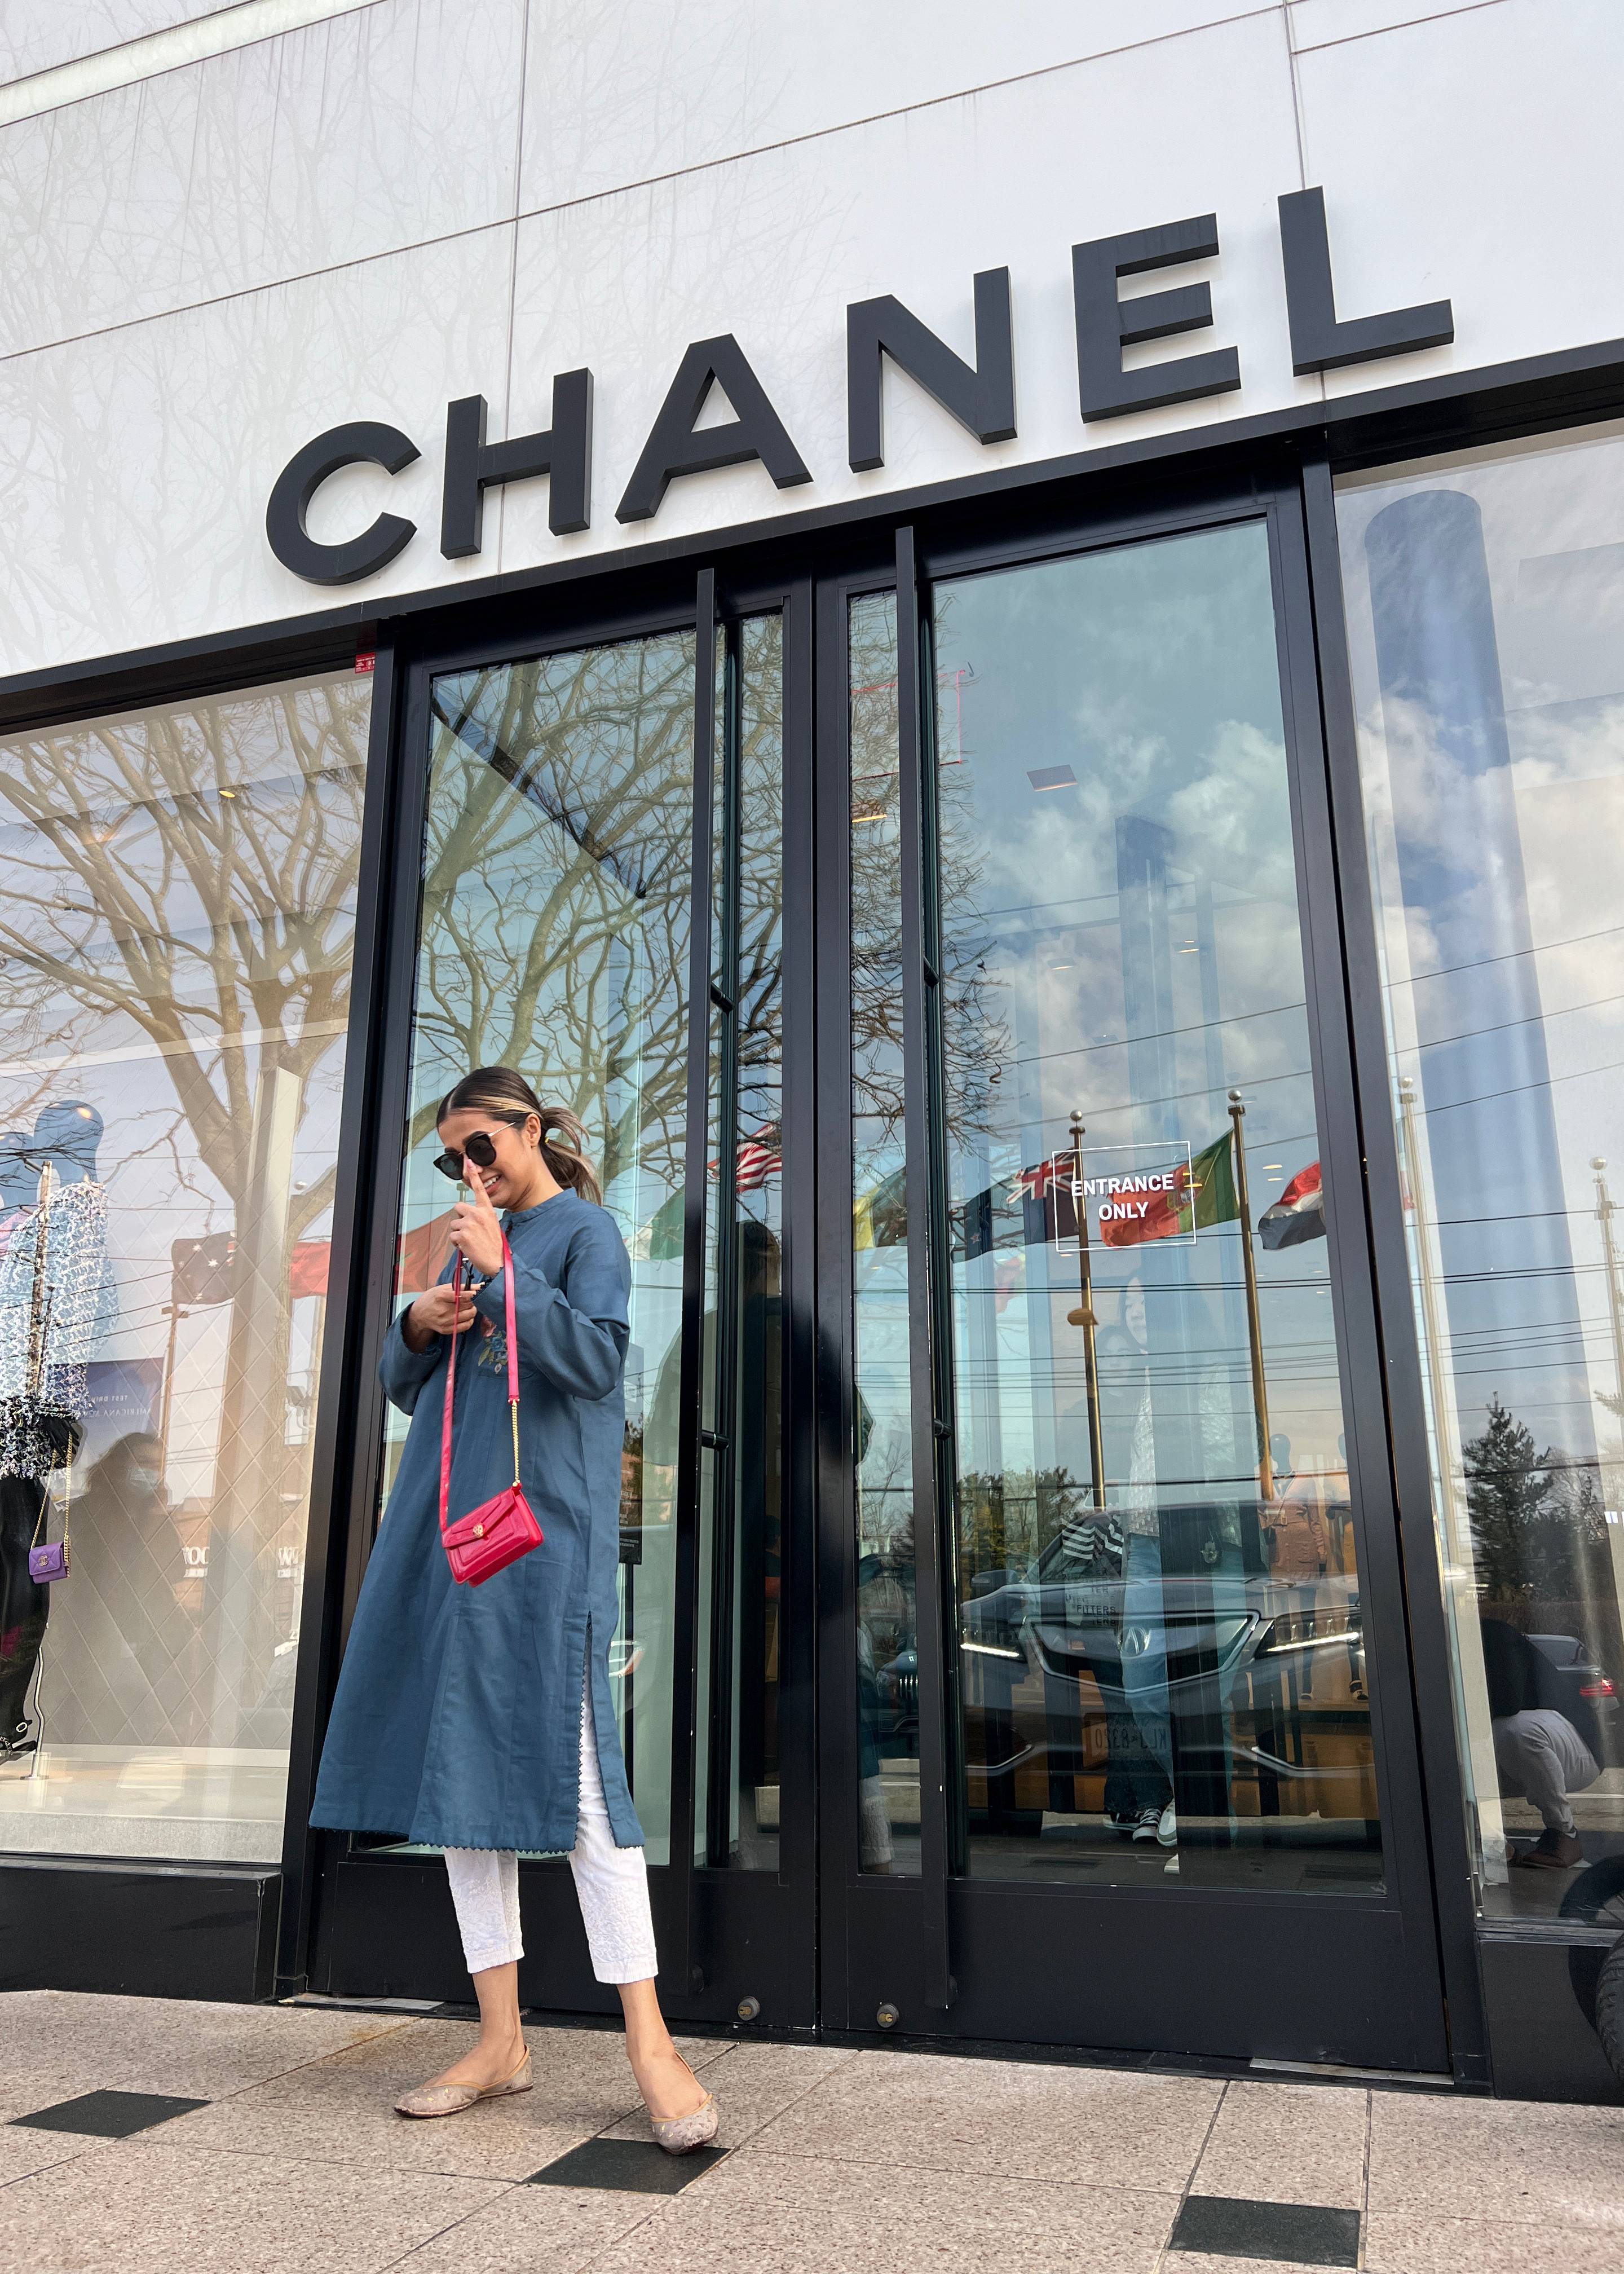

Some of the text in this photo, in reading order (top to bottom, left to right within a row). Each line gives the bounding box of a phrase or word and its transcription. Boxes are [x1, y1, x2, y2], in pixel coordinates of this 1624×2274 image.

[266, 186, 1454, 587] CHANEL
[1071, 1174, 1174, 1196] ENTRANCE
[1098, 1201, 1149, 1220] ONLY
